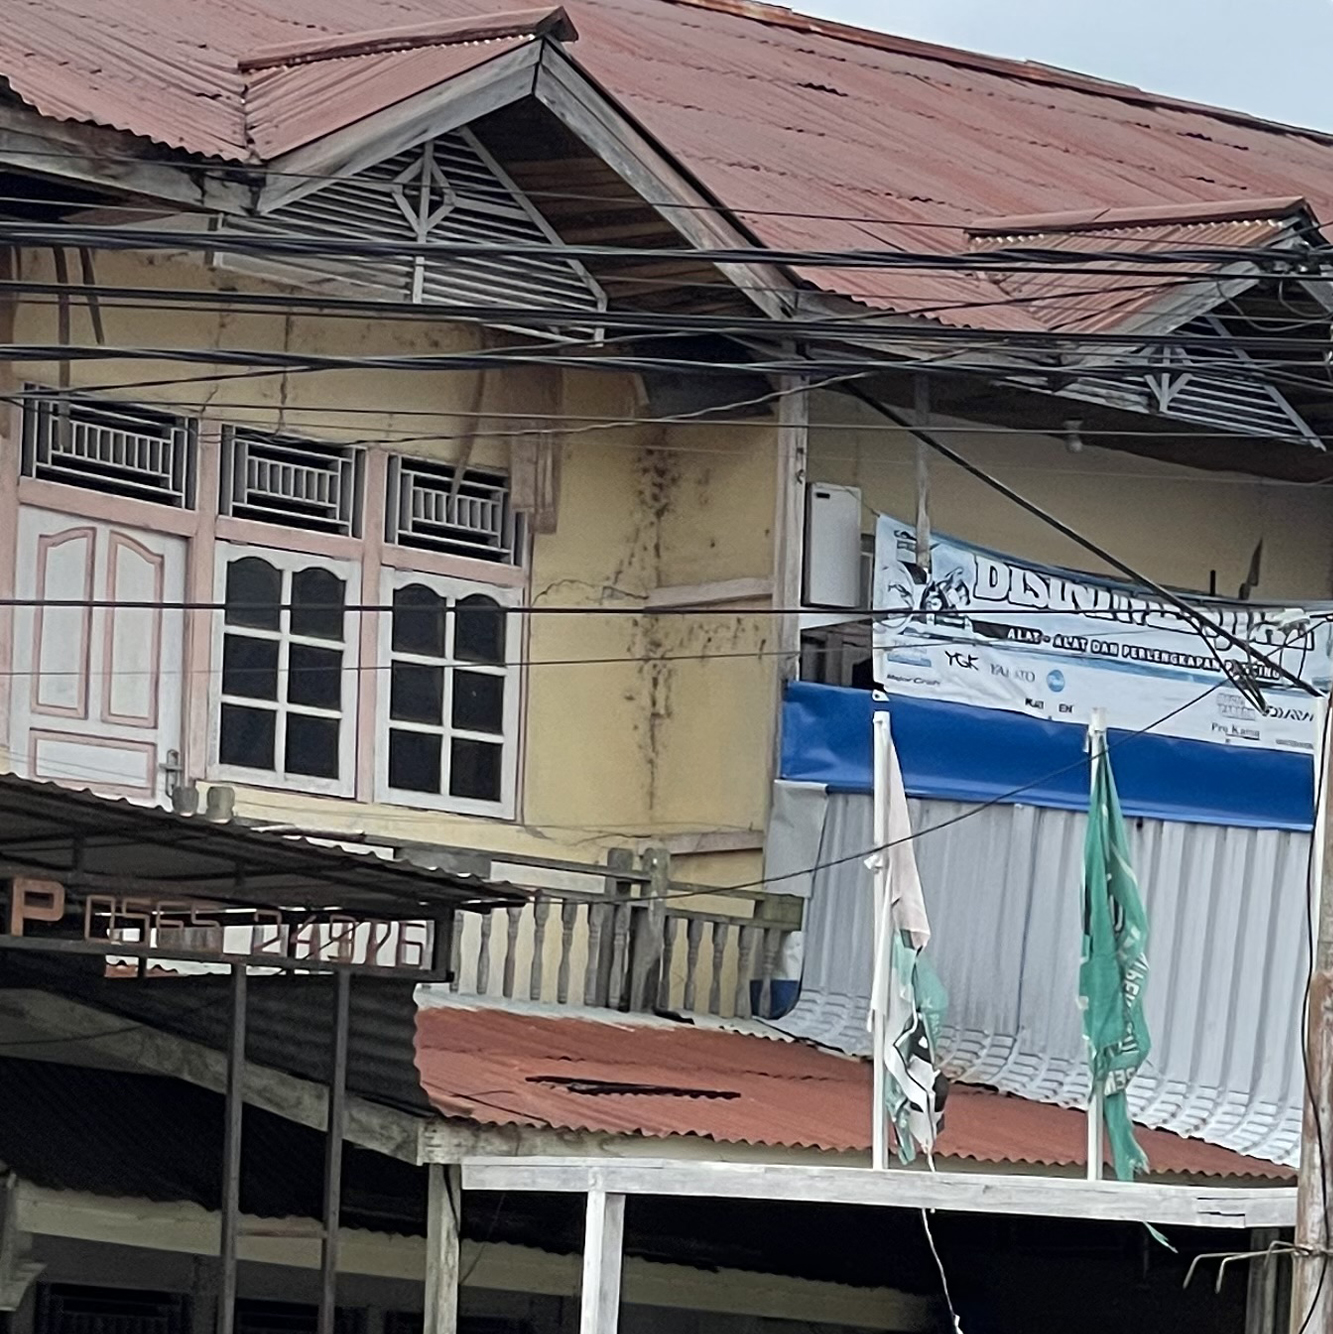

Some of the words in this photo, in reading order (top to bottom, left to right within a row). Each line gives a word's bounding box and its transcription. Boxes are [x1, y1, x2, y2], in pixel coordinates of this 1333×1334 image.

[945, 650, 979, 671] YGK
[1007, 628, 1041, 644] ALAT
[1053, 634, 1088, 652] ALAT
[1123, 646, 1221, 671] PERLENGKAPAN
